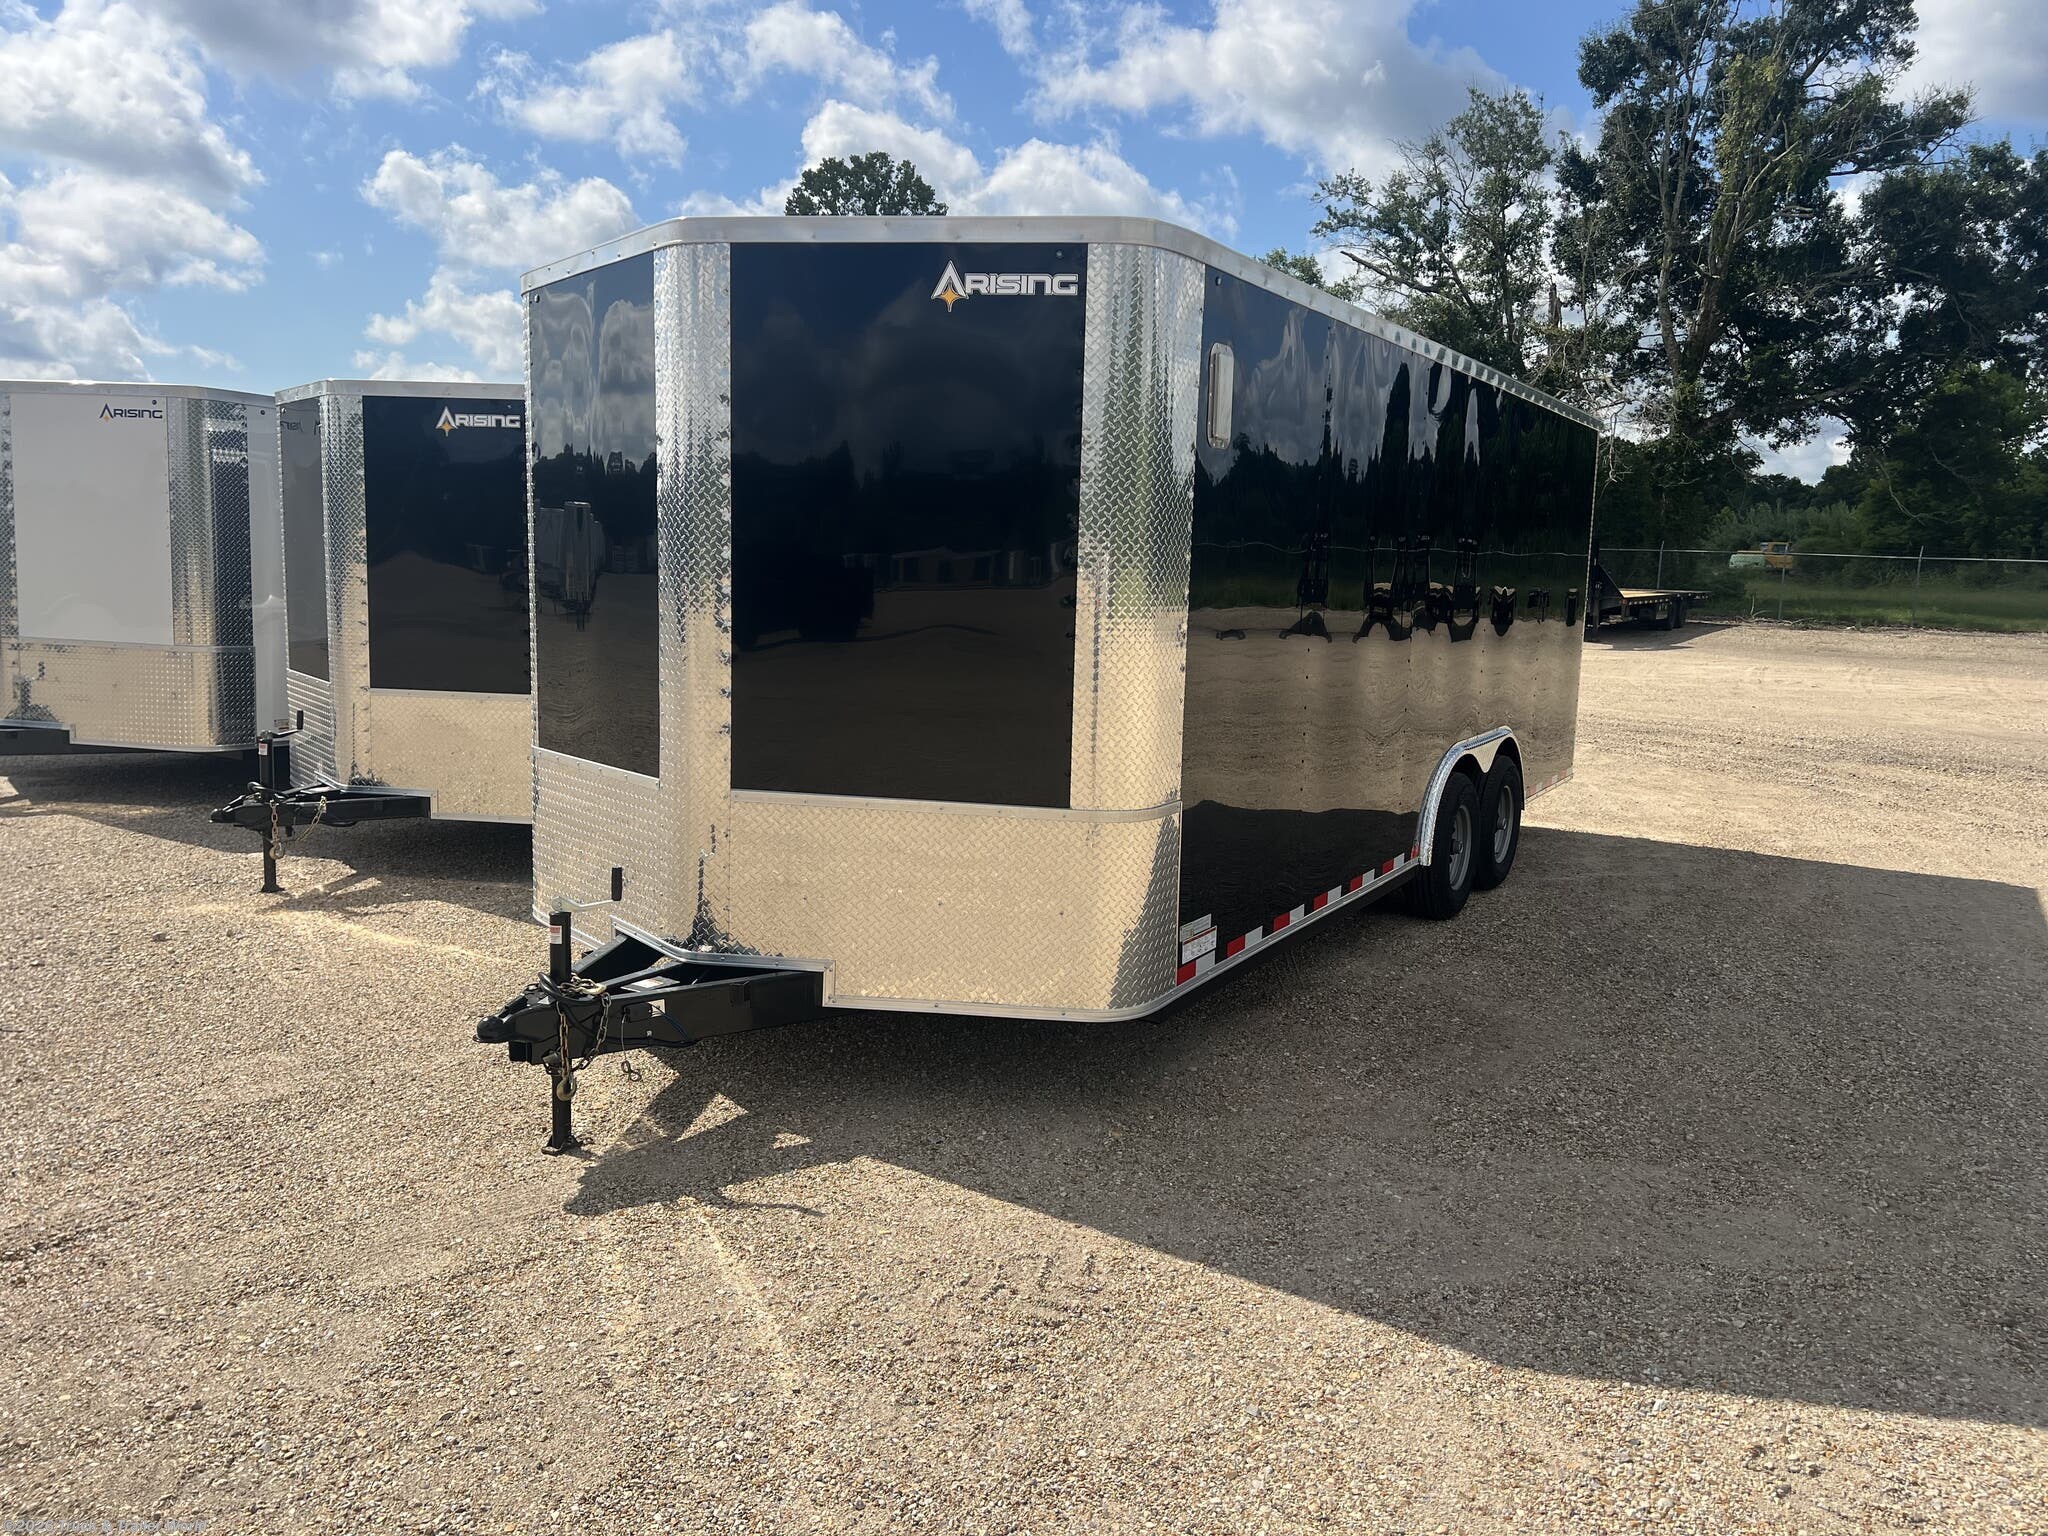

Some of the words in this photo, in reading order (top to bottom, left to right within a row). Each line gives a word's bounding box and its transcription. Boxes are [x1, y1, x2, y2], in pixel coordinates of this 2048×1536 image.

[931, 260, 1079, 303] ARISING
[100, 403, 163, 421] ARISING
[435, 405, 521, 431] ARISING
